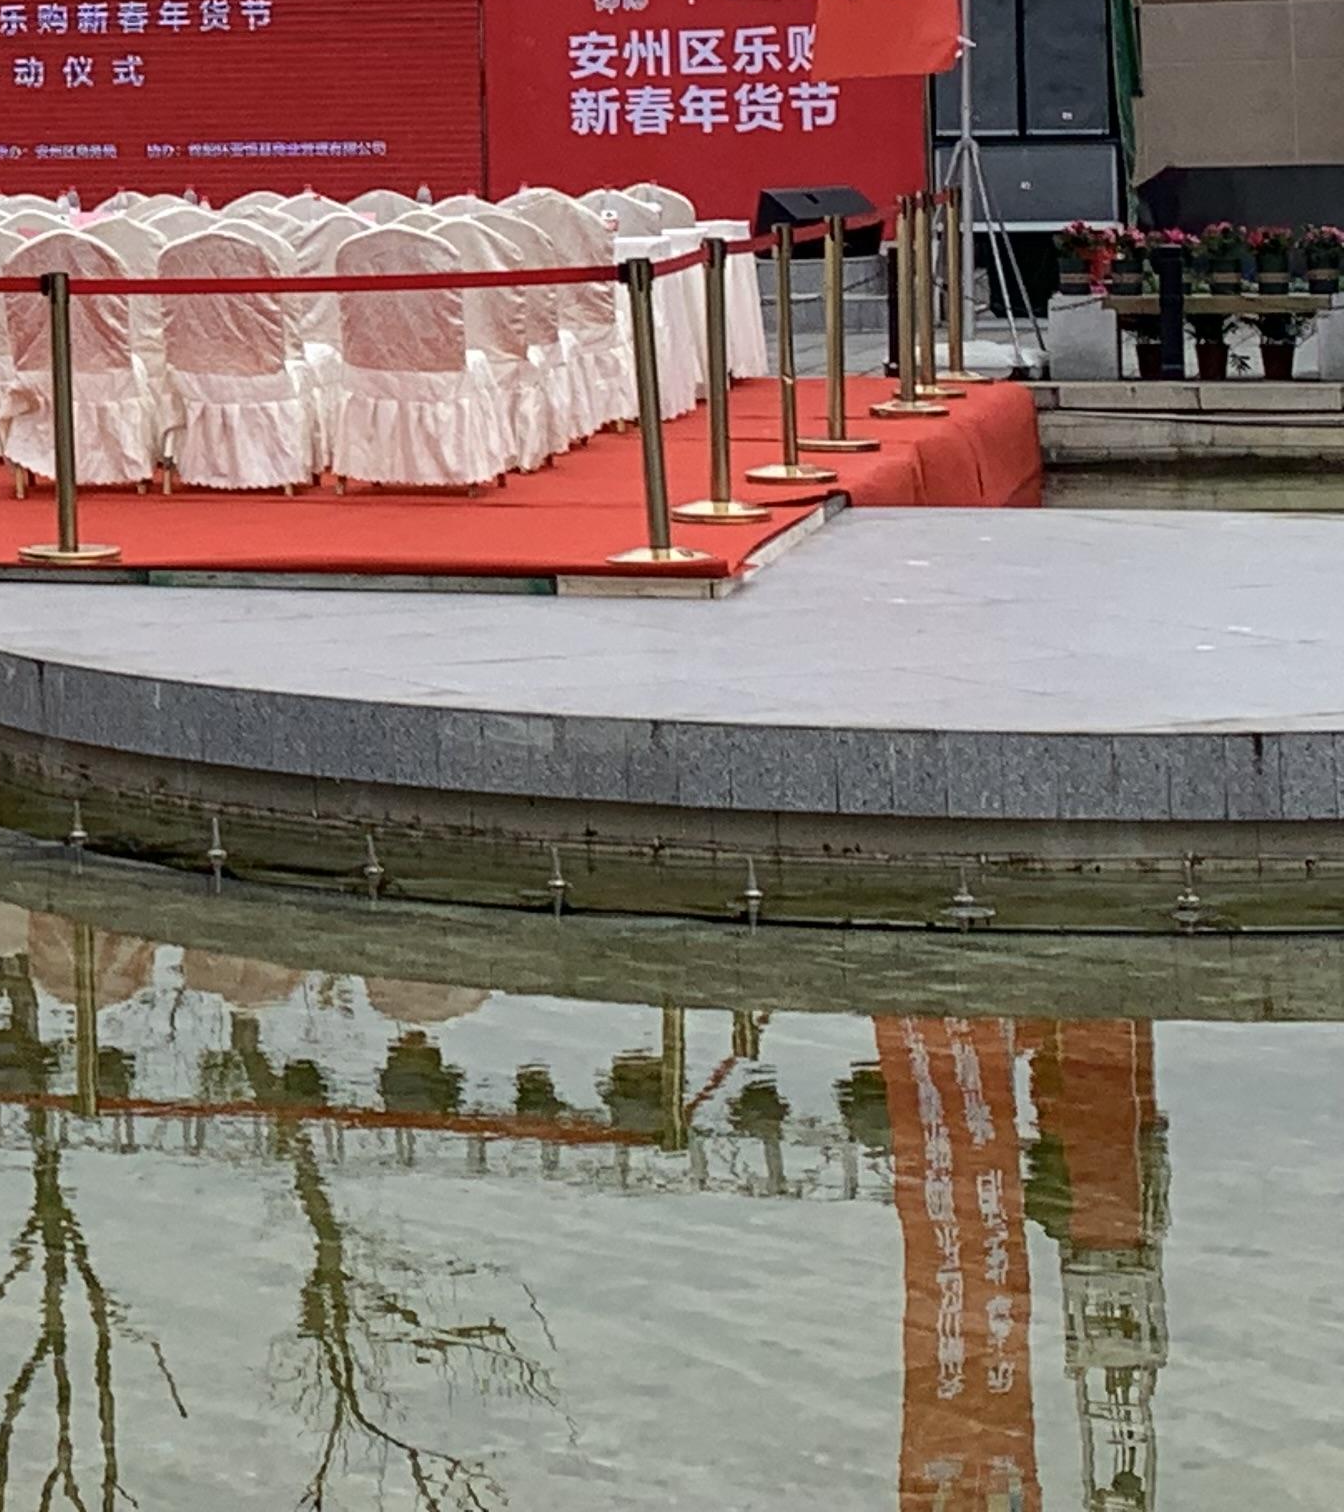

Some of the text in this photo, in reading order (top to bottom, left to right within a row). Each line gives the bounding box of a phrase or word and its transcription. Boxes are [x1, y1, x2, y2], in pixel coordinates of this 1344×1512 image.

[569, 81, 841, 137] 新春年货节
